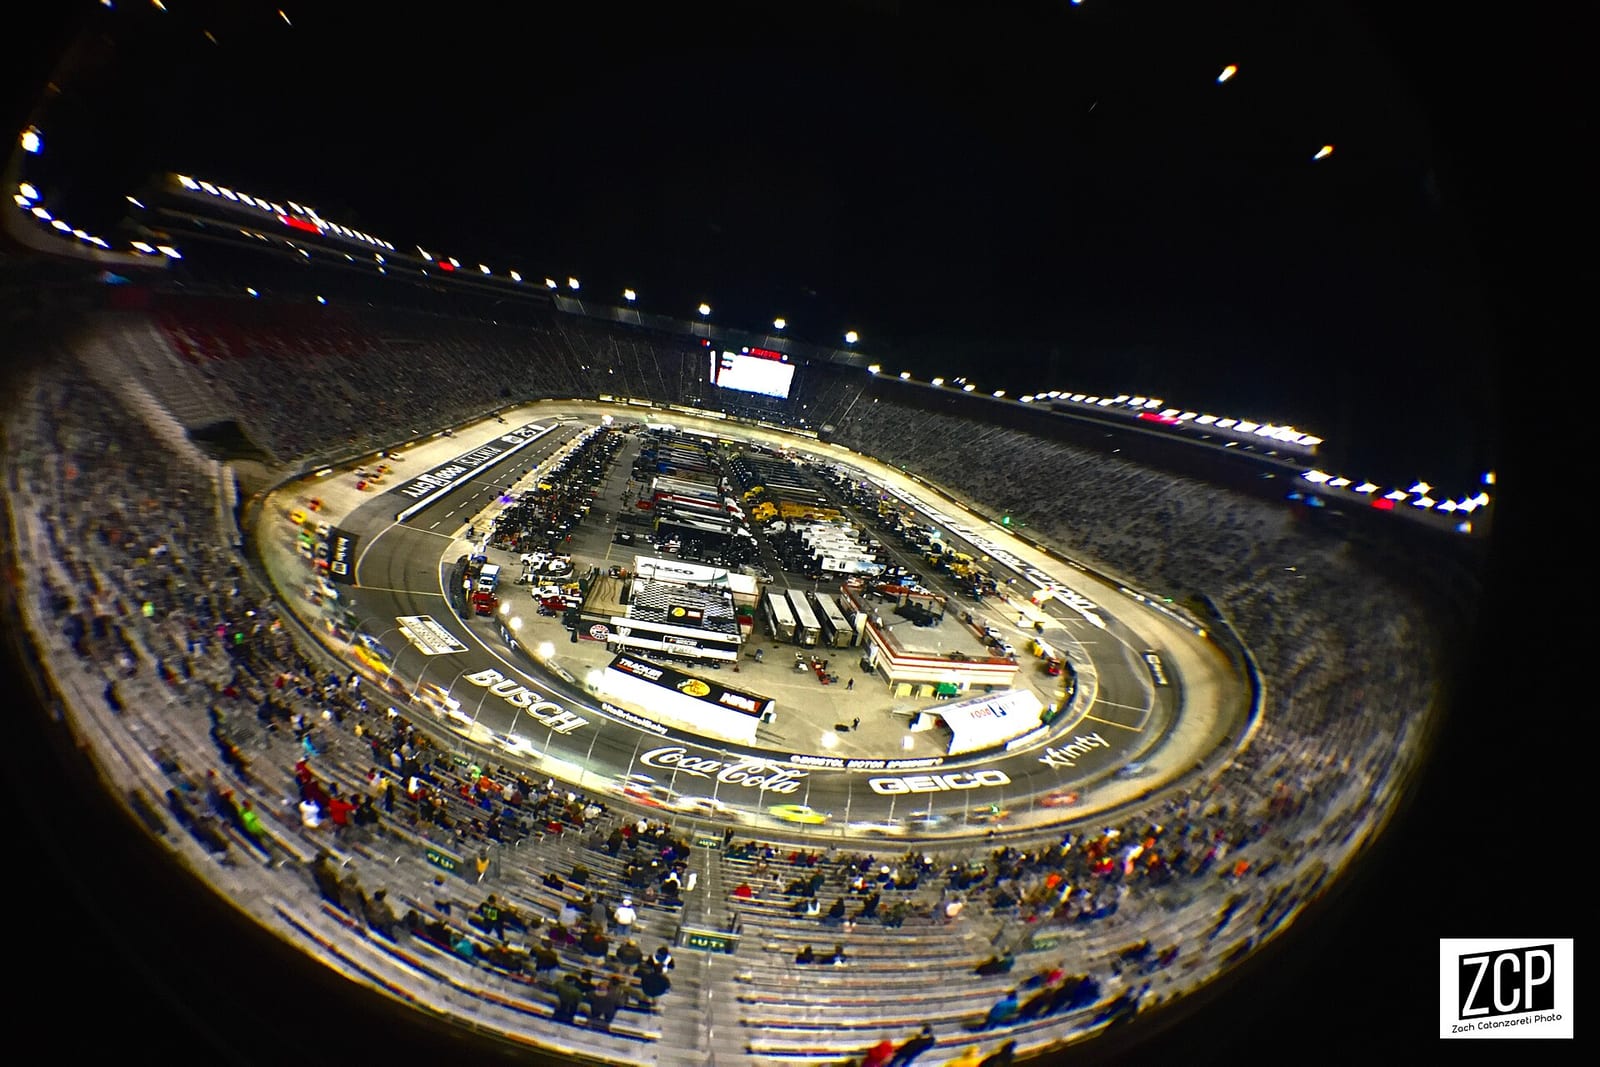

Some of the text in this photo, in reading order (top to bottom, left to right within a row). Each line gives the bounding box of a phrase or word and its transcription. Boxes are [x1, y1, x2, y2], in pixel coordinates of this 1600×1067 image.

[462, 668, 590, 735] BUSCH
[639, 746, 810, 794] Coca-Cola
[846, 759, 886, 769] MOTOR
[1038, 731, 1110, 770] xfinity
[868, 769, 1011, 795] GEICO
